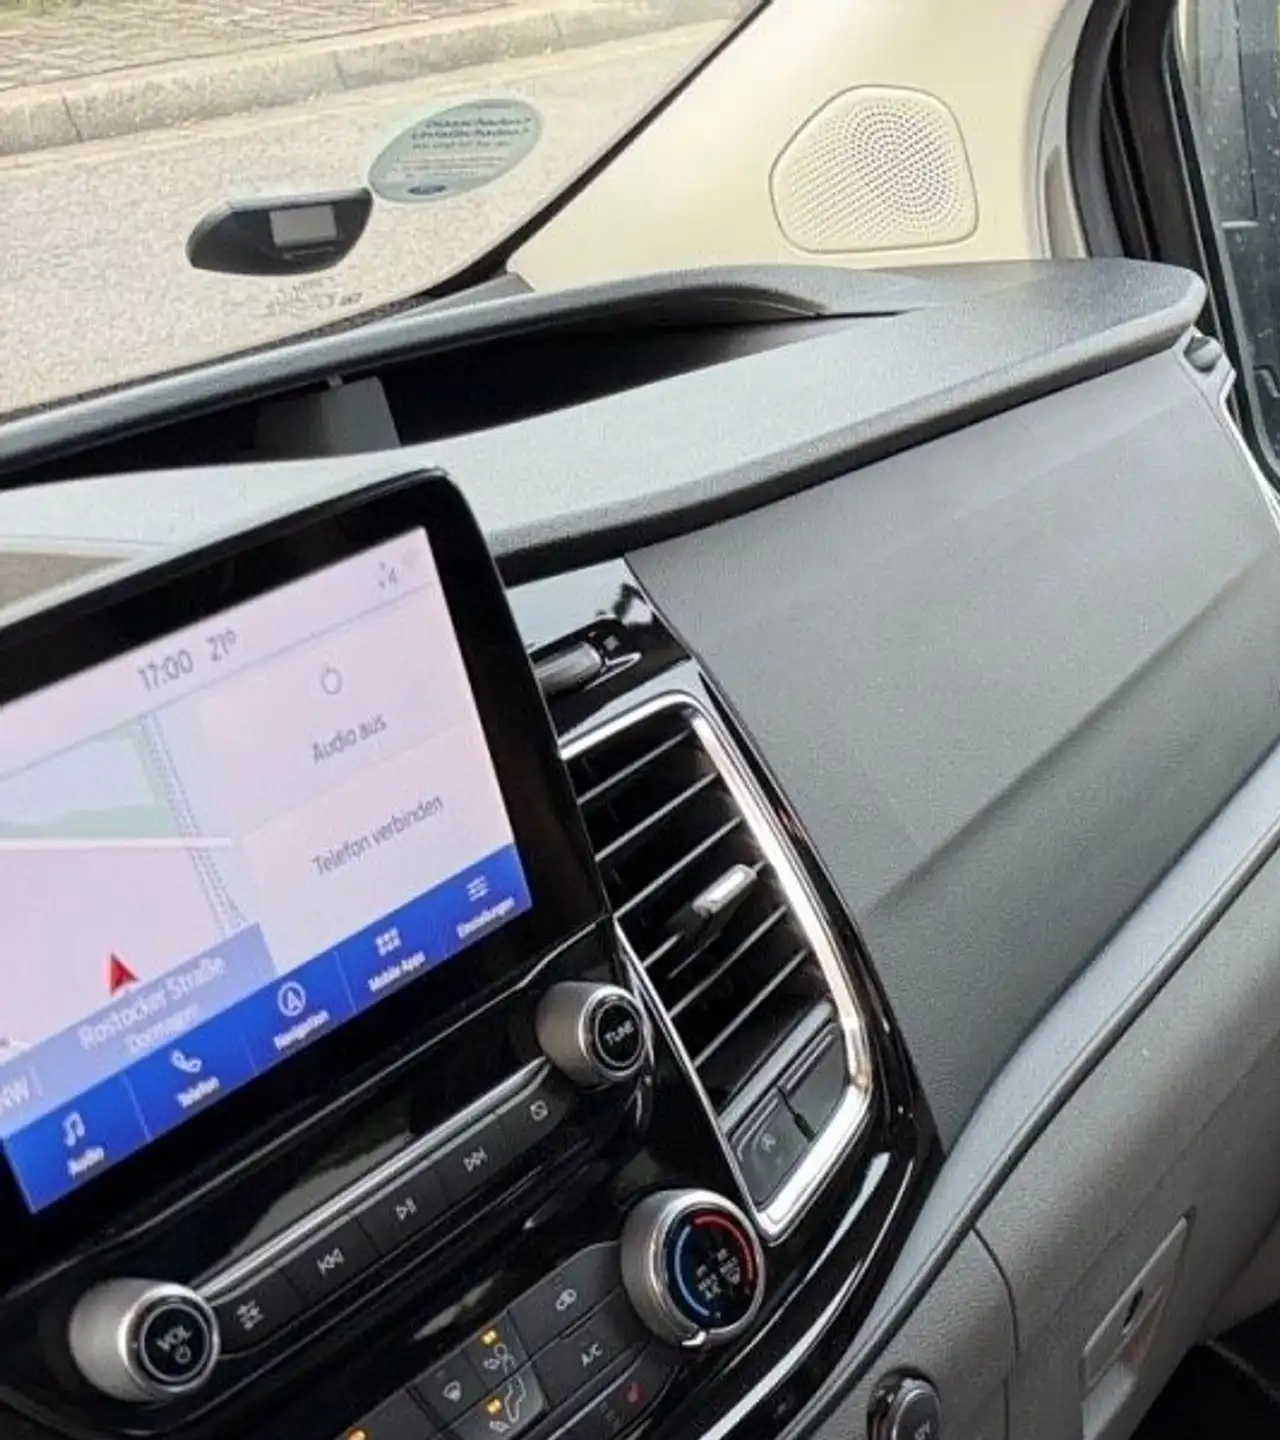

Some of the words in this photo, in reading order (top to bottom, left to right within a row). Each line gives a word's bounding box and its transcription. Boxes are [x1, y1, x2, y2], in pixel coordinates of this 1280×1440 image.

[136, 648, 194, 692] 17:00
[311, 728, 357, 765] Audio
[358, 713, 387, 741] aus
[311, 834, 372, 876] Telefon
[371, 795, 444, 846] verbinden
[367, 964, 402, 993] Mobile
[400, 950, 427, 974] Apps
[77, 988, 168, 1050] Rostocker
[165, 957, 227, 1000] Straße
[603, 1019, 635, 1046] TUNE
[156, 1325, 192, 1351] VOL
[580, 1343, 603, 1366] A/C
